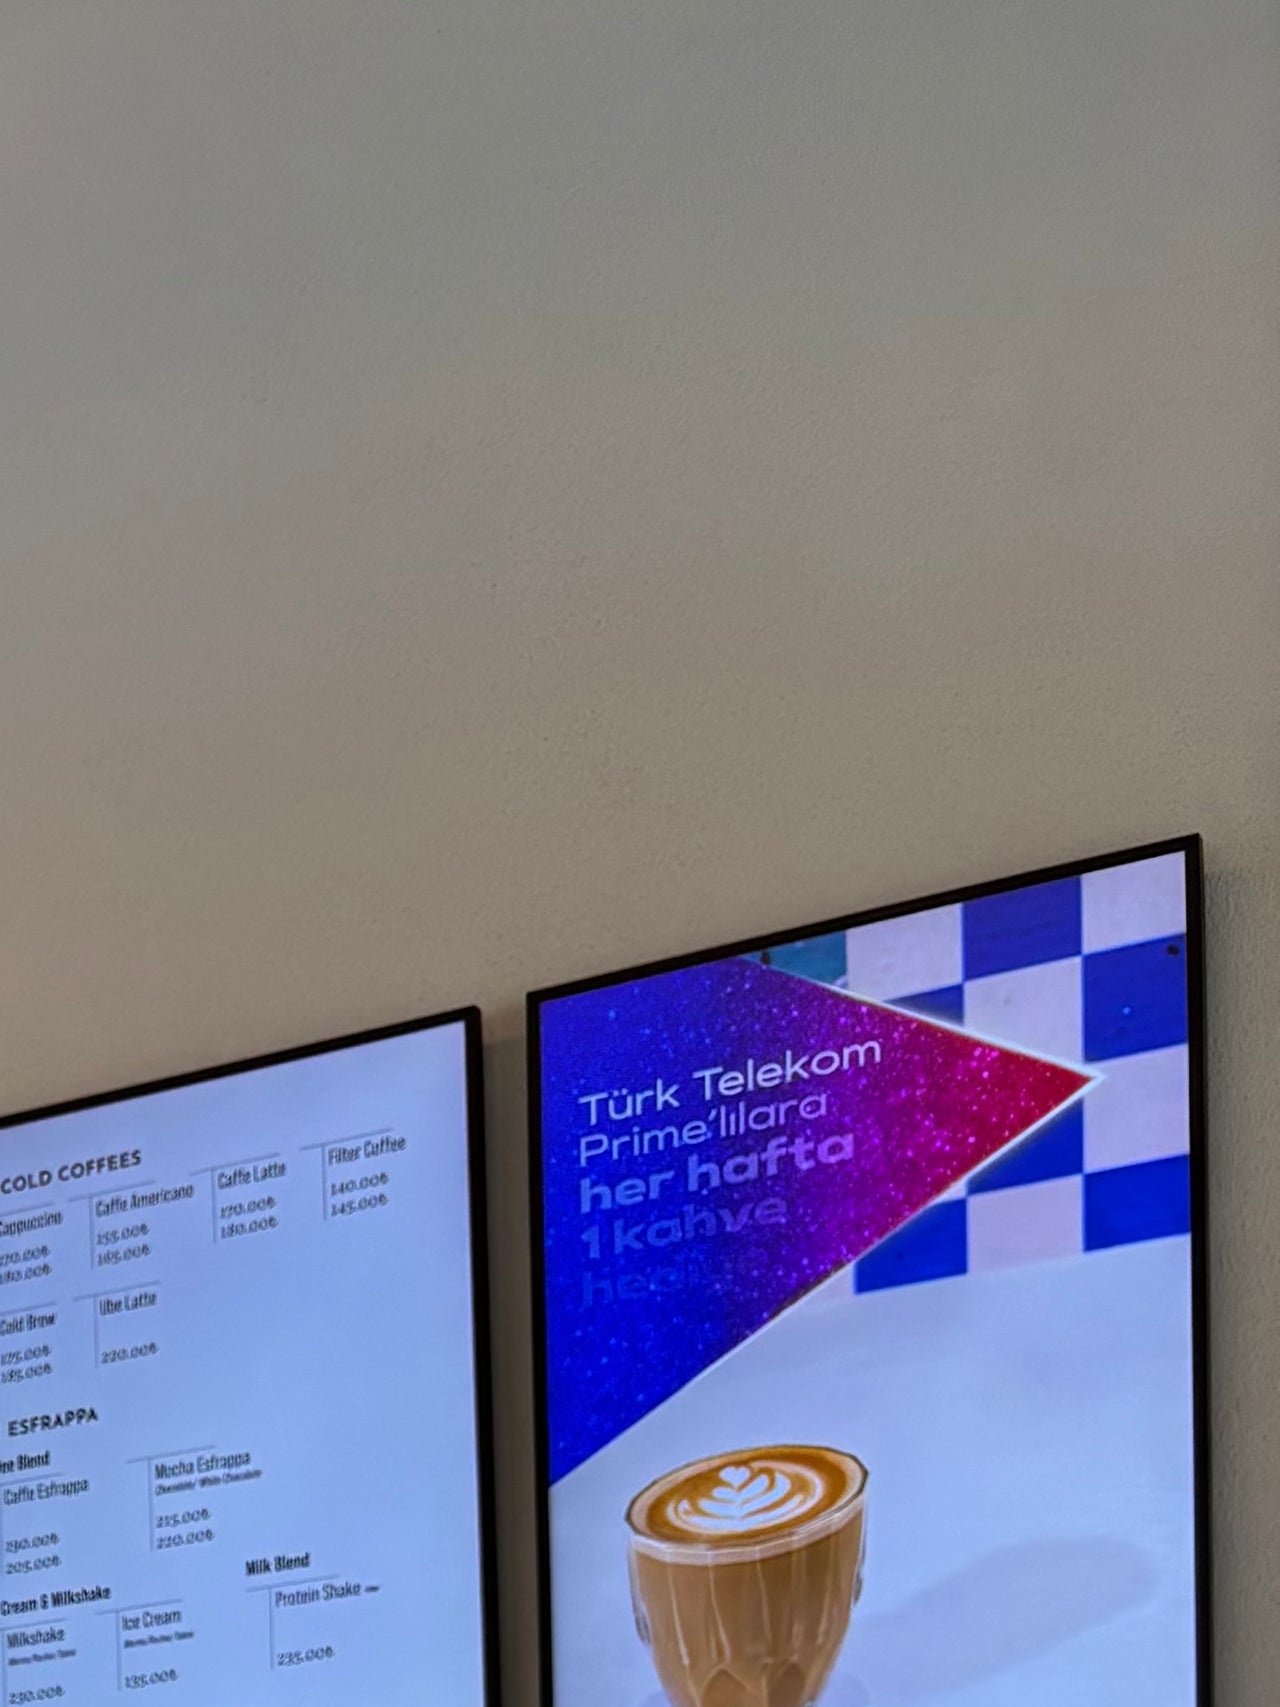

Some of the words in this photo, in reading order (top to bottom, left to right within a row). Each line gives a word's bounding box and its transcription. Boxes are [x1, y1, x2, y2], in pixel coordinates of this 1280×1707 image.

[578, 1078, 680, 1125] Türk
[692, 1039, 882, 1100] Telekom
[580, 1094, 827, 1167] Prime'lılara
[0, 1170, 52, 1195] COLD
[58, 1149, 142, 1182] COFFEES
[580, 1171, 675, 1214] her
[688, 1133, 854, 1191] hafta
[581, 1226, 600, 1258] 1
[615, 1198, 787, 1254] kahve
[8, 1407, 99, 1437] ESFRAPPA
